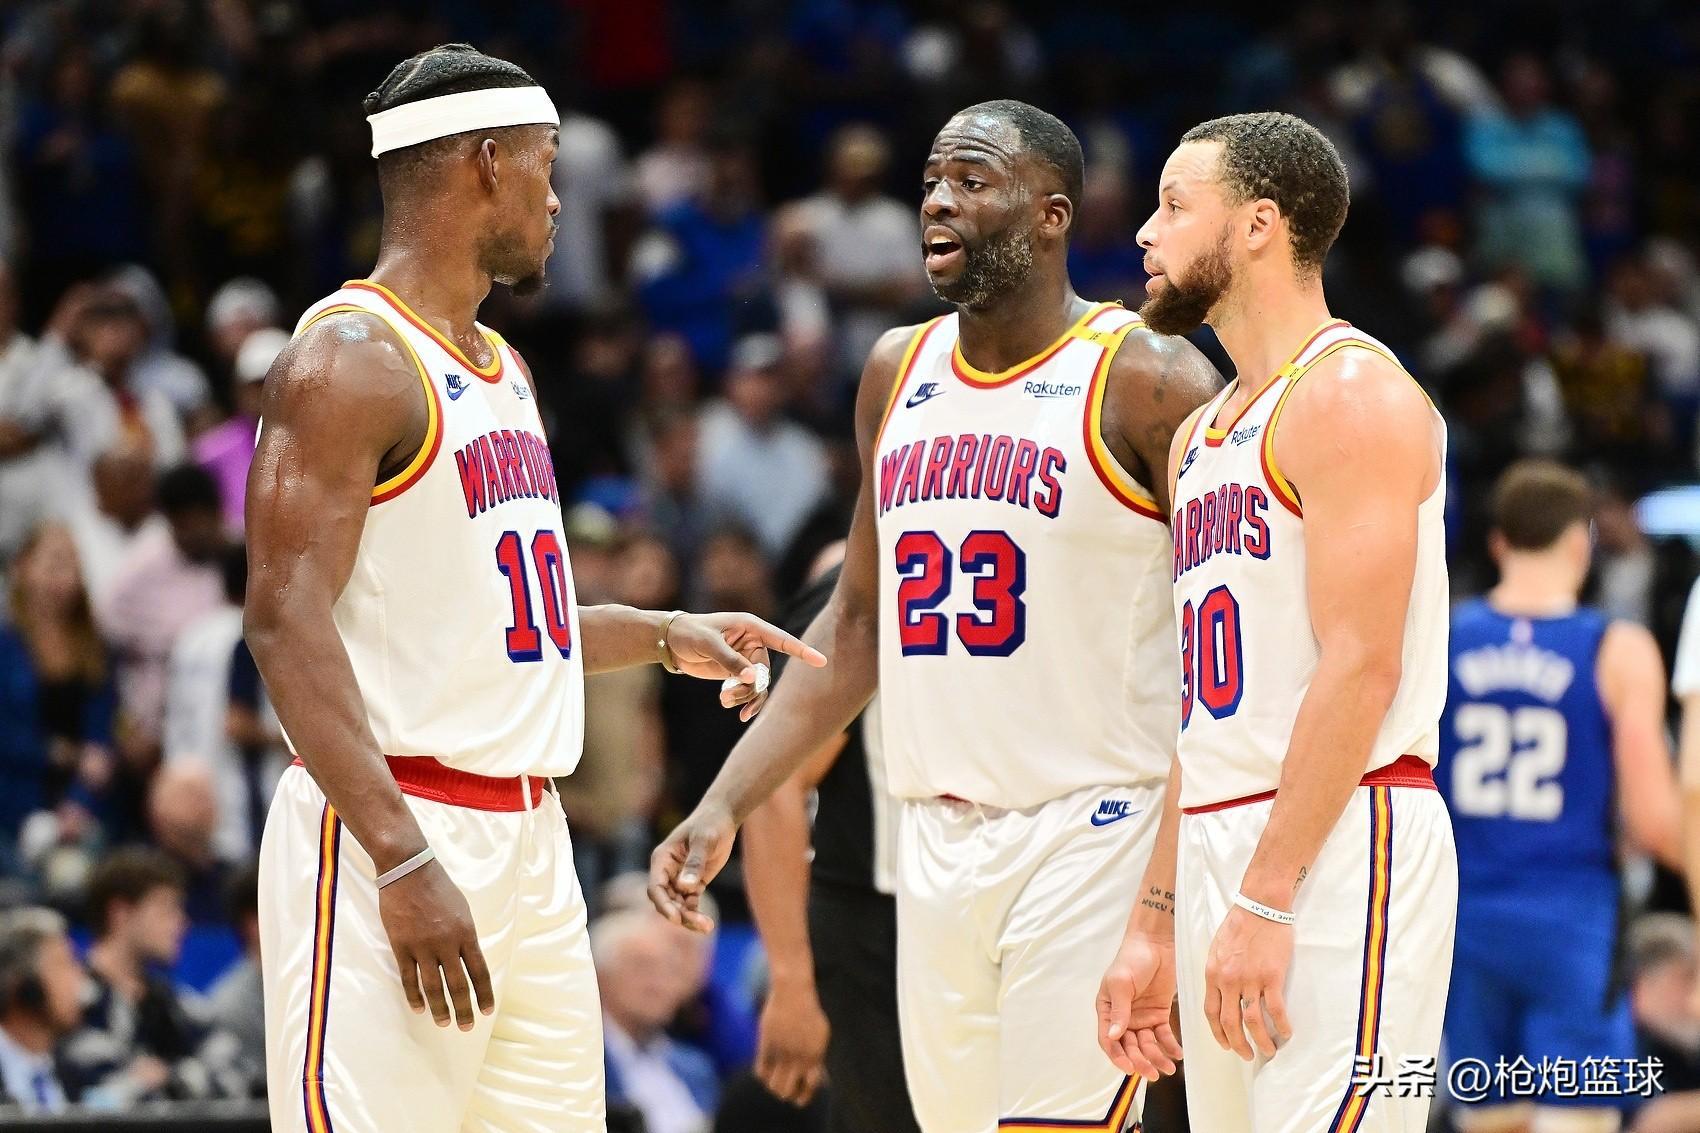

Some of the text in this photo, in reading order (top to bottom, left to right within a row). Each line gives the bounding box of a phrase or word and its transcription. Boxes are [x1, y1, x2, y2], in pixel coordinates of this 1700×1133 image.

[1024, 381, 1081, 397] Rakuten
[454, 429, 559, 519] WARRIOR
[880, 433, 1067, 519] WARRIORS
[495, 529, 571, 663] 10
[895, 530, 1026, 657] 23
[1098, 800, 1131, 815] NIKE
[1452, 702, 1568, 823] 22
